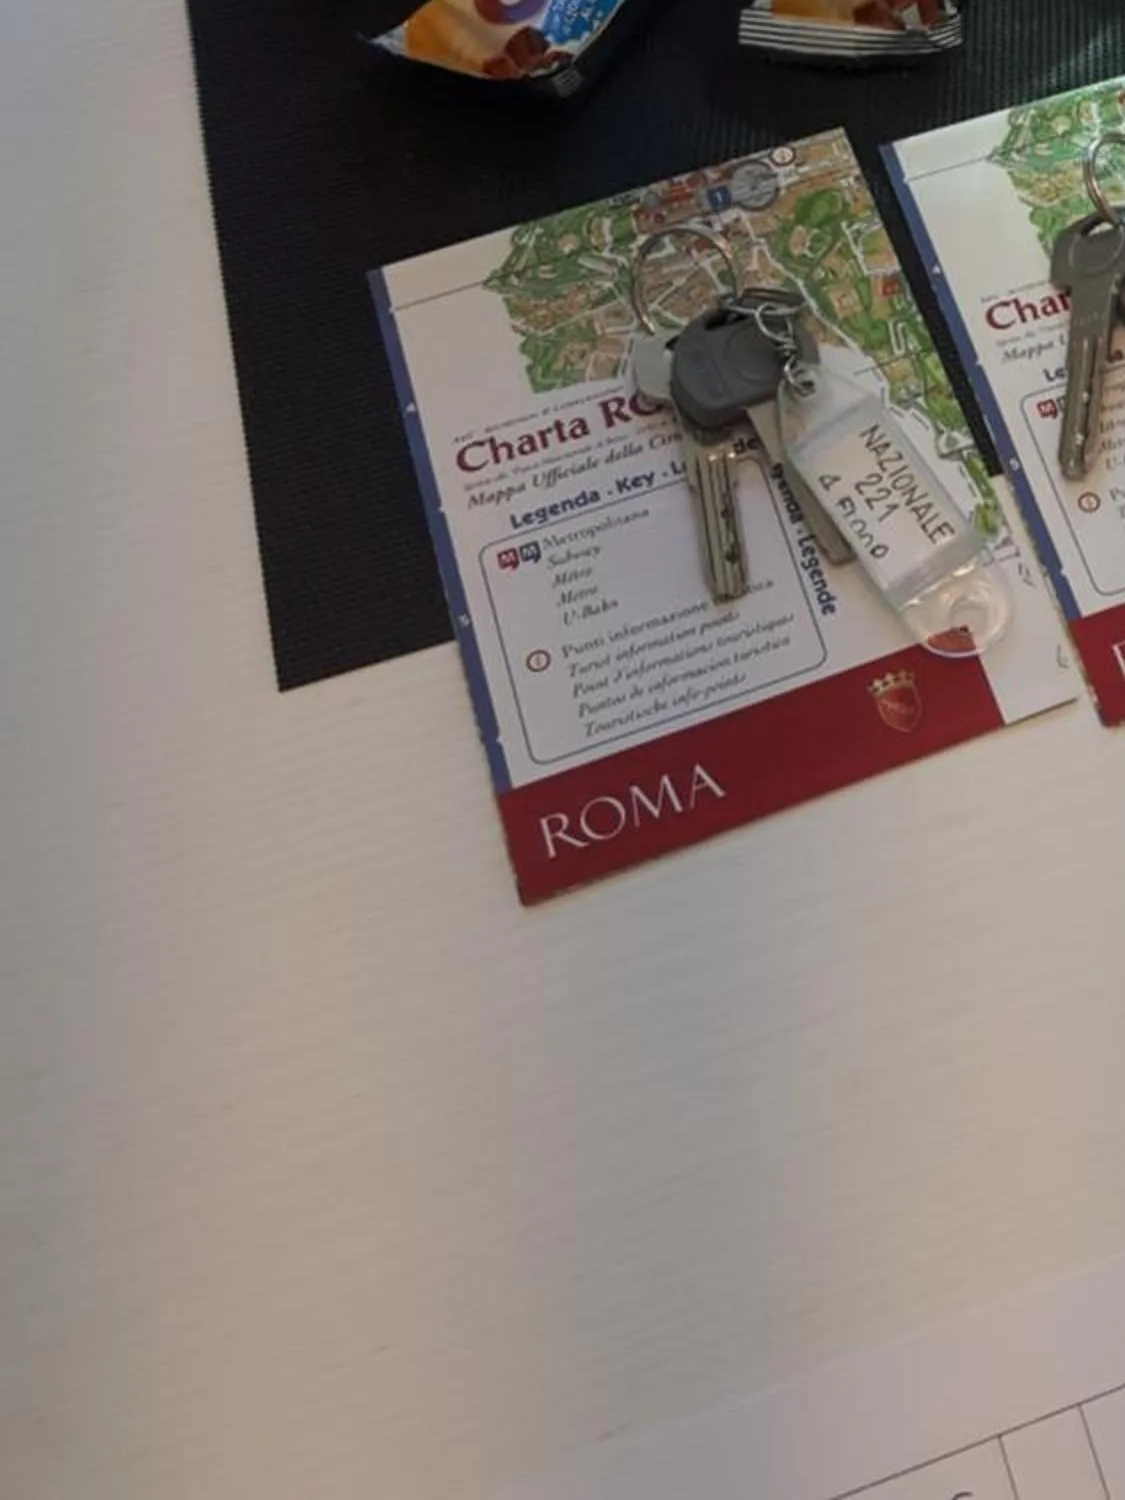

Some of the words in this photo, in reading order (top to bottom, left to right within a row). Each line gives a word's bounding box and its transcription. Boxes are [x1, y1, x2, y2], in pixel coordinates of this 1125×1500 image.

[455, 420, 590, 474] Charta
[465, 479, 528, 511] Mappa
[510, 488, 600, 530] Legenda
[616, 471, 655, 499] Key
[854, 470, 901, 523] 221
[859, 422, 956, 545] NAZIONALE
[797, 534, 837, 616] Legende
[538, 763, 726, 860] ROMA
